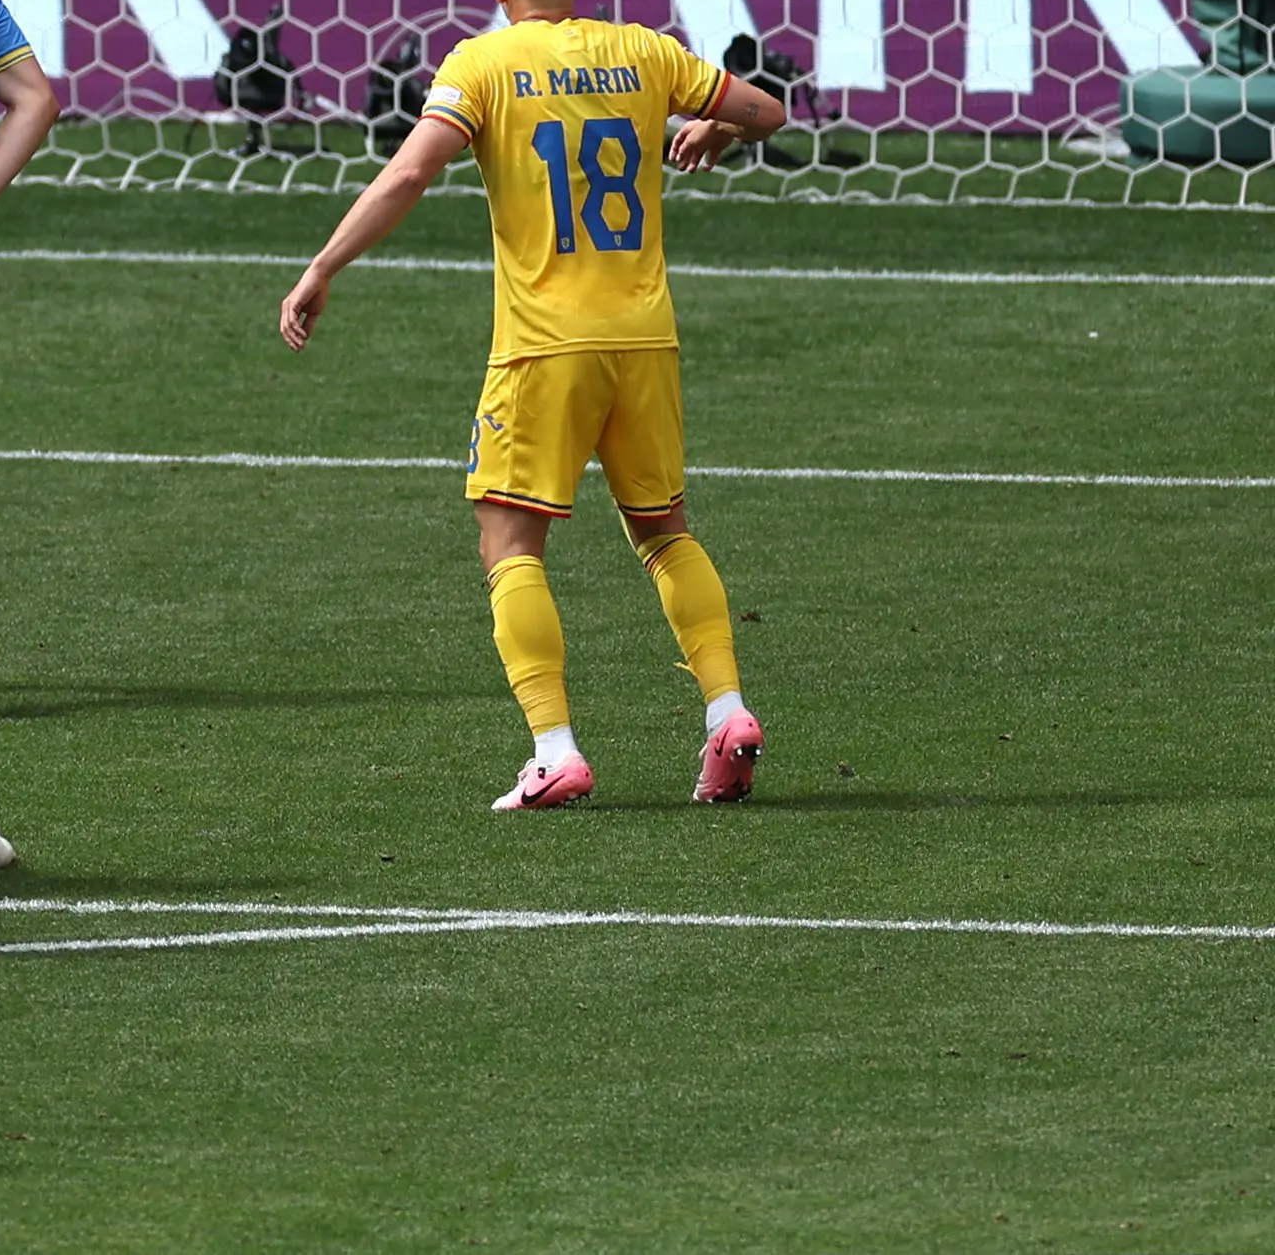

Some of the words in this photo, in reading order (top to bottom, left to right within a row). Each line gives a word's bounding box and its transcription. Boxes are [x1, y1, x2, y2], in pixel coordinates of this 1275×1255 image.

[513, 70, 543, 98] R.
[551, 64, 643, 97] MARIN
[532, 118, 645, 255] 18
